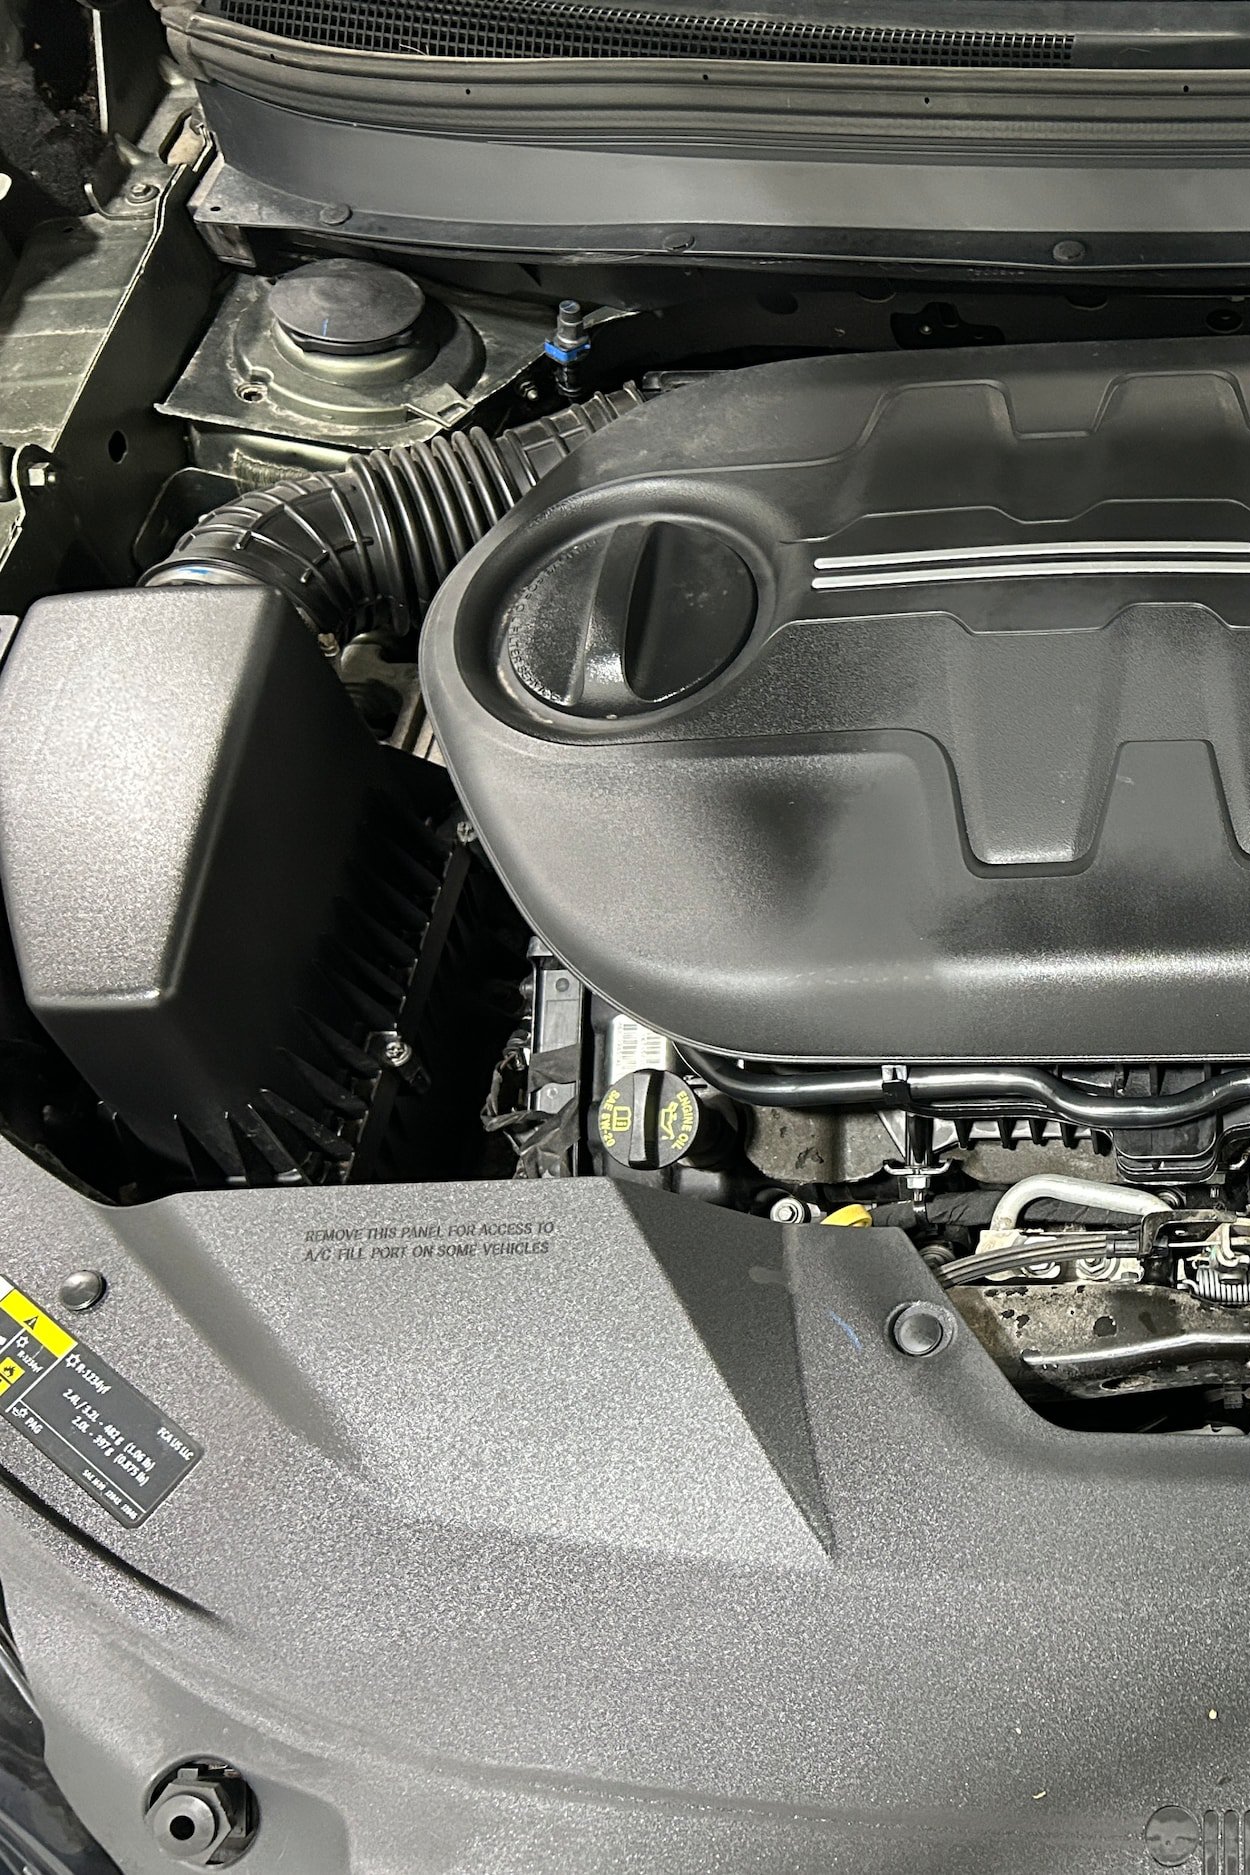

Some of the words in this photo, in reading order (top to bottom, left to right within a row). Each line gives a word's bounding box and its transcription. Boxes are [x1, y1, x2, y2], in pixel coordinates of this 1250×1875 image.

[676, 1090, 694, 1132] ENGINE
[671, 1133, 689, 1150] OIL
[304, 1228, 363, 1243] REMOVE
[366, 1227, 397, 1240] THIS
[401, 1226, 443, 1239] PANEL
[449, 1224, 476, 1237] FOR
[480, 1222, 533, 1236] ACCESS
[537, 1221, 555, 1234] TO
[304, 1249, 332, 1262] A/C
[338, 1247, 367, 1261] FILL
[371, 1246, 407, 1260] PORT
[412, 1245, 435, 1258] ON
[437, 1244, 478, 1257] SOME
[484, 1241, 550, 1256] VEHICLES
[25, 1417, 43, 1435] PAG
[157, 1427, 173, 1444] FCA
[170, 1438, 183, 1452] US
[178, 1447, 195, 1461] LLC
